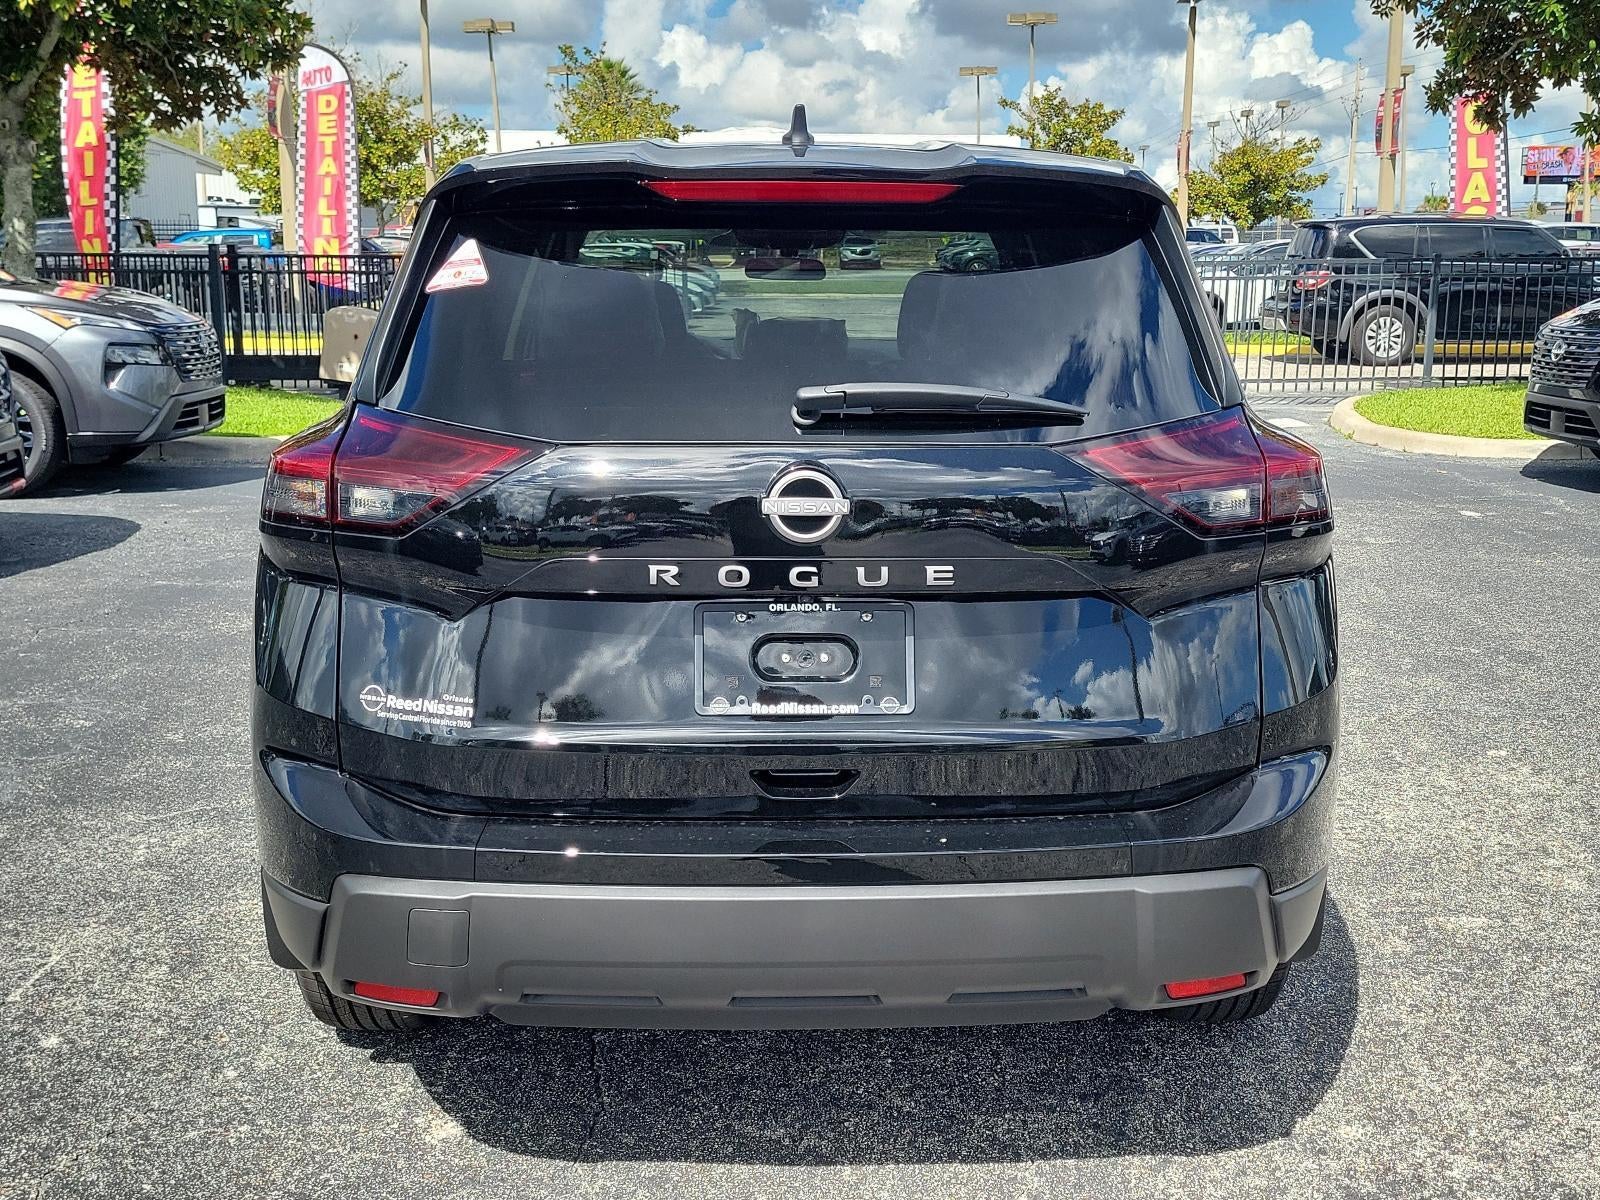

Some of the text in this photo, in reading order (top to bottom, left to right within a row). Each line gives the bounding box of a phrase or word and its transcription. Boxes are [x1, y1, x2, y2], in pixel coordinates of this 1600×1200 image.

[301, 65, 332, 87] AUTO
[72, 63, 111, 287] ETAILIN
[764, 502, 848, 513] NISSAN
[647, 564, 956, 587] ROGUE
[768, 603, 841, 612] ORLANDO, FL.
[442, 693, 474, 703] Orlando
